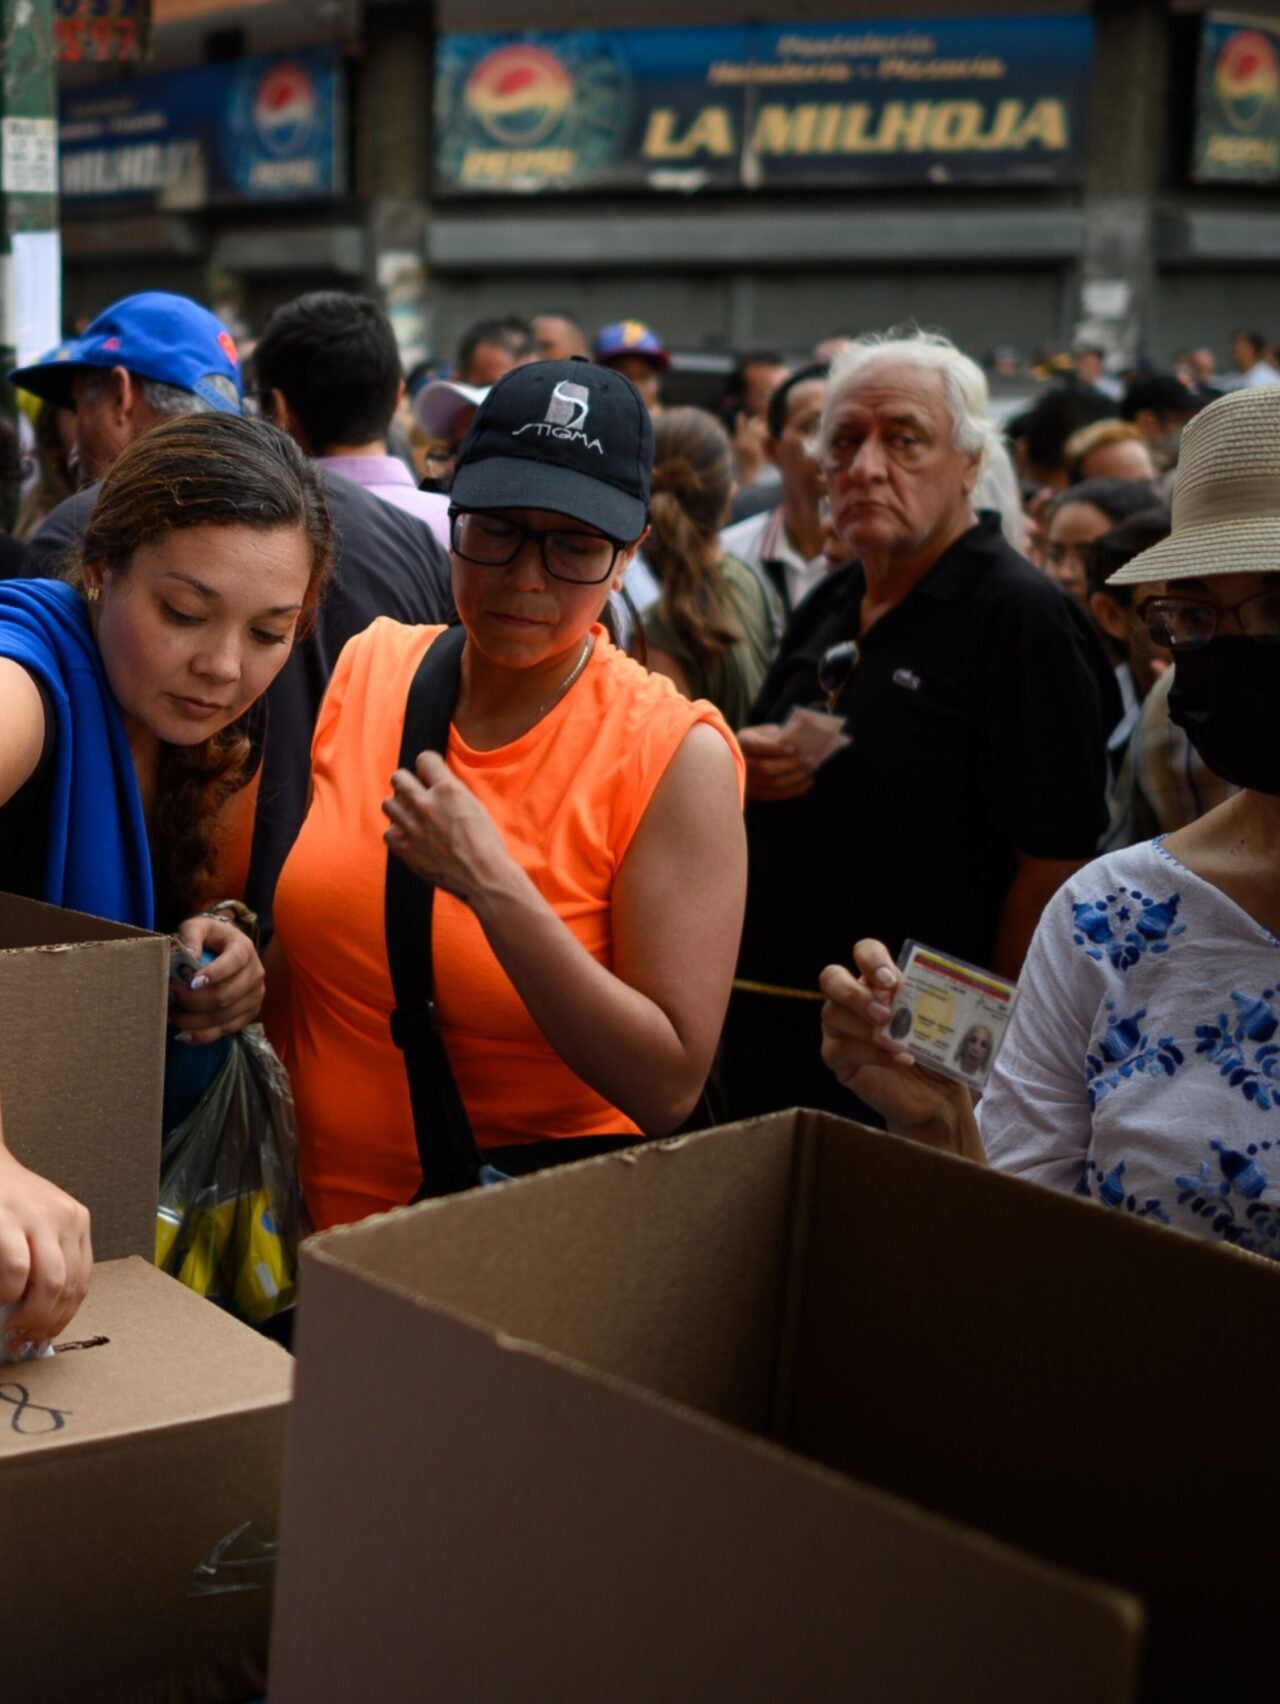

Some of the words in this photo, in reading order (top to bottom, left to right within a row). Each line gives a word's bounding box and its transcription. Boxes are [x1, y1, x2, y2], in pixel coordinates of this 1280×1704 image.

[643, 107, 733, 158] LA
[748, 98, 1070, 156] MILHOJA
[512, 422, 604, 455] STIGMA
